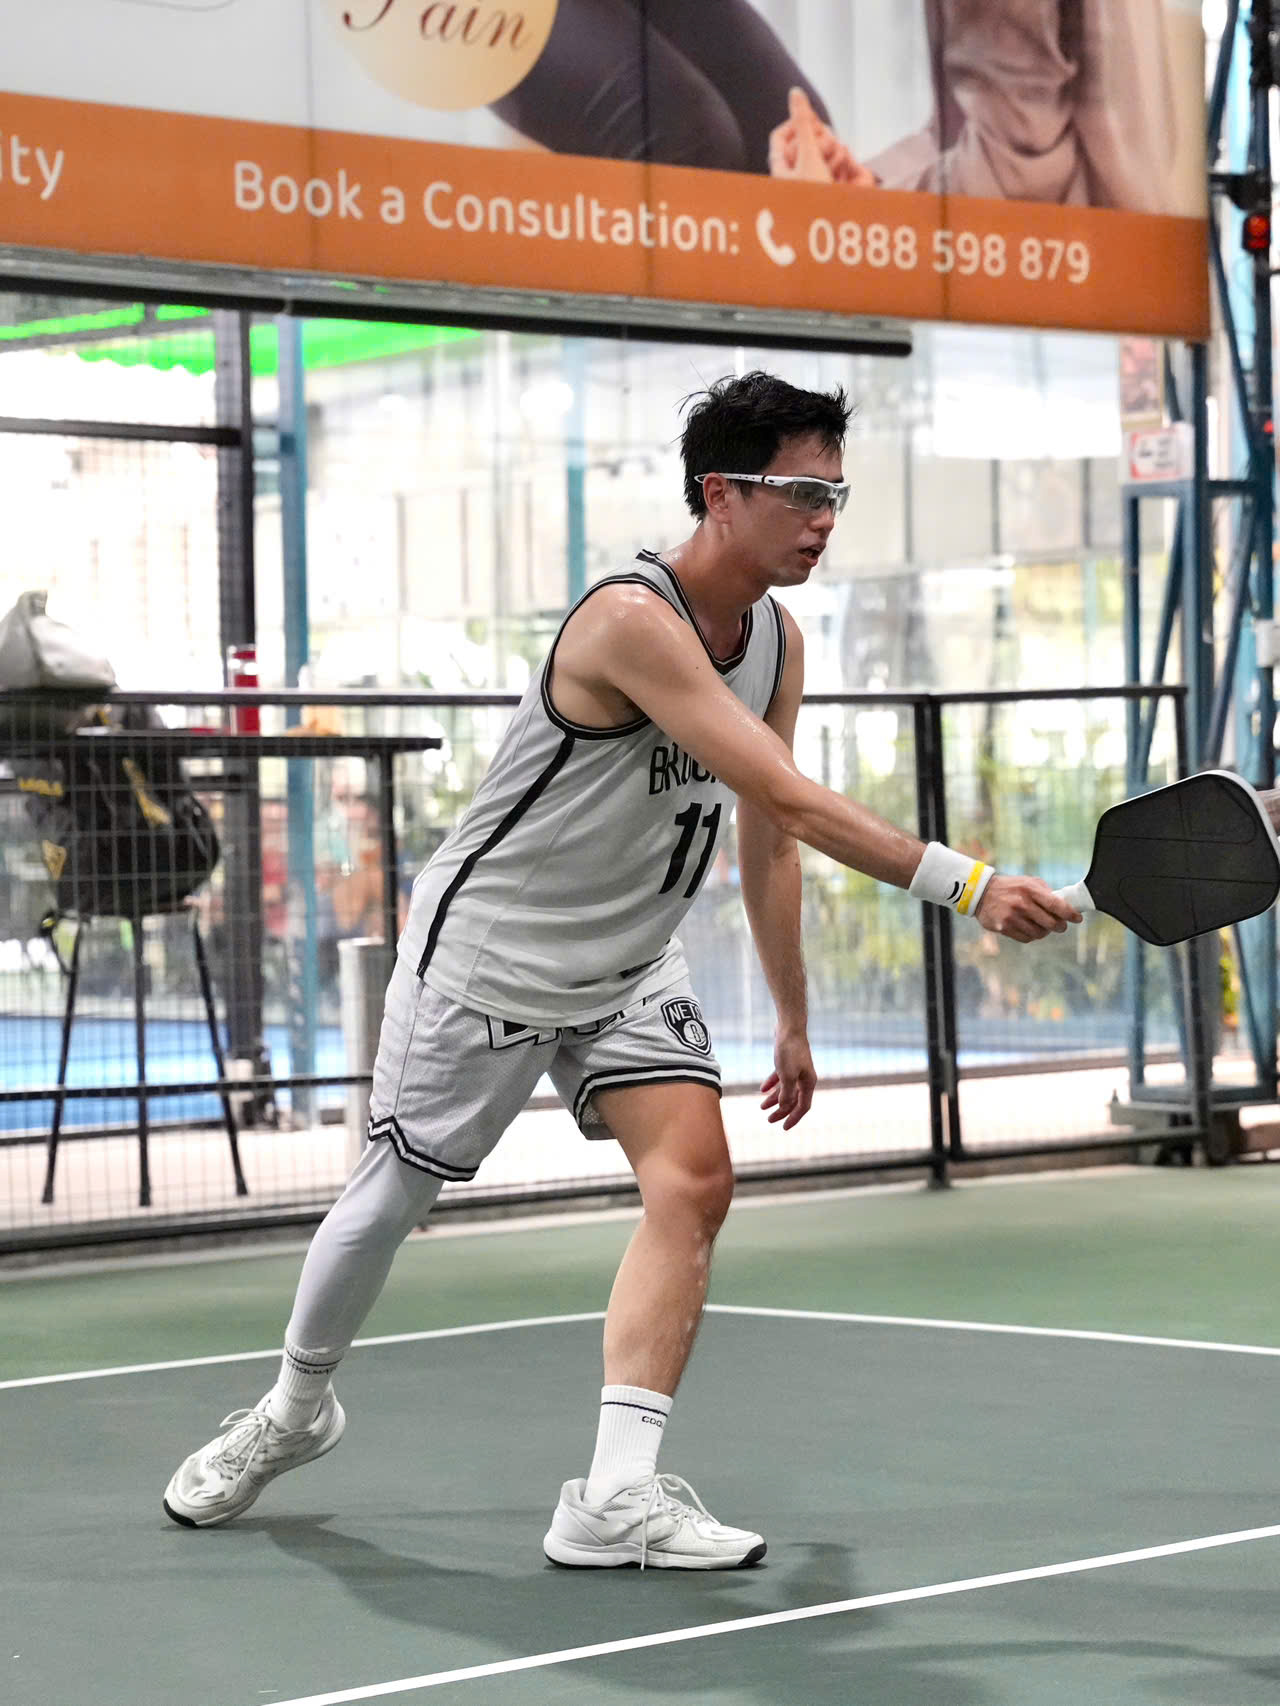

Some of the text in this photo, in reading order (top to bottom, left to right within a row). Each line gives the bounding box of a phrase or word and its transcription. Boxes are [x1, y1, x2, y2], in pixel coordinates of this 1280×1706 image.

[234, 160, 1091, 284] Book a Consultation: 0888 598 879
[649, 741, 718, 795] BROO
[658, 802, 722, 899] 11
